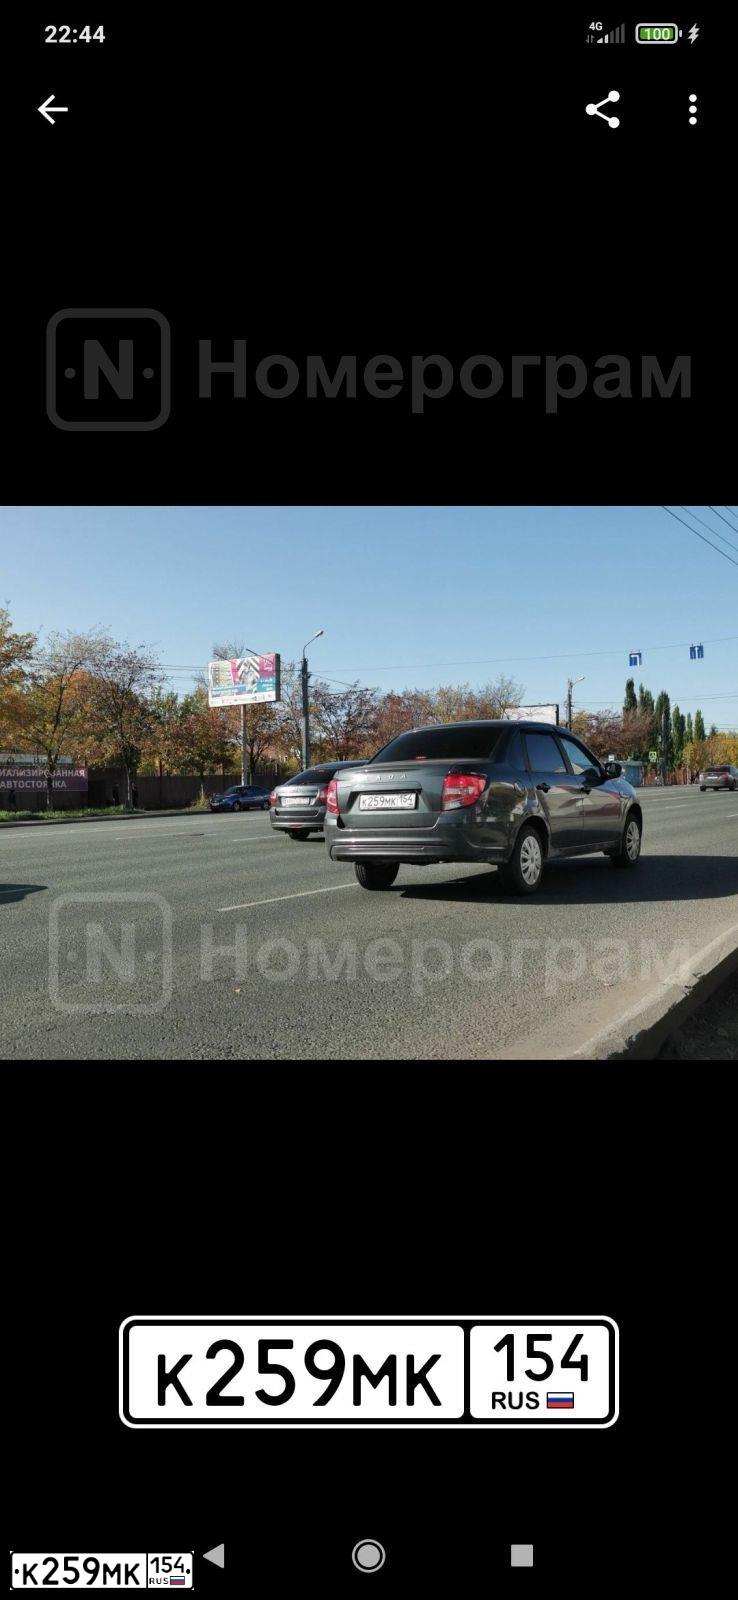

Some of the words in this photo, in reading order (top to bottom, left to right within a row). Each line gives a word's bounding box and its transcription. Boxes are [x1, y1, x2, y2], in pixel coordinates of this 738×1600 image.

[589, 22, 603, 31] 4G
[45, 25, 106, 43] 22:44
[645, 28, 671, 40] 100
